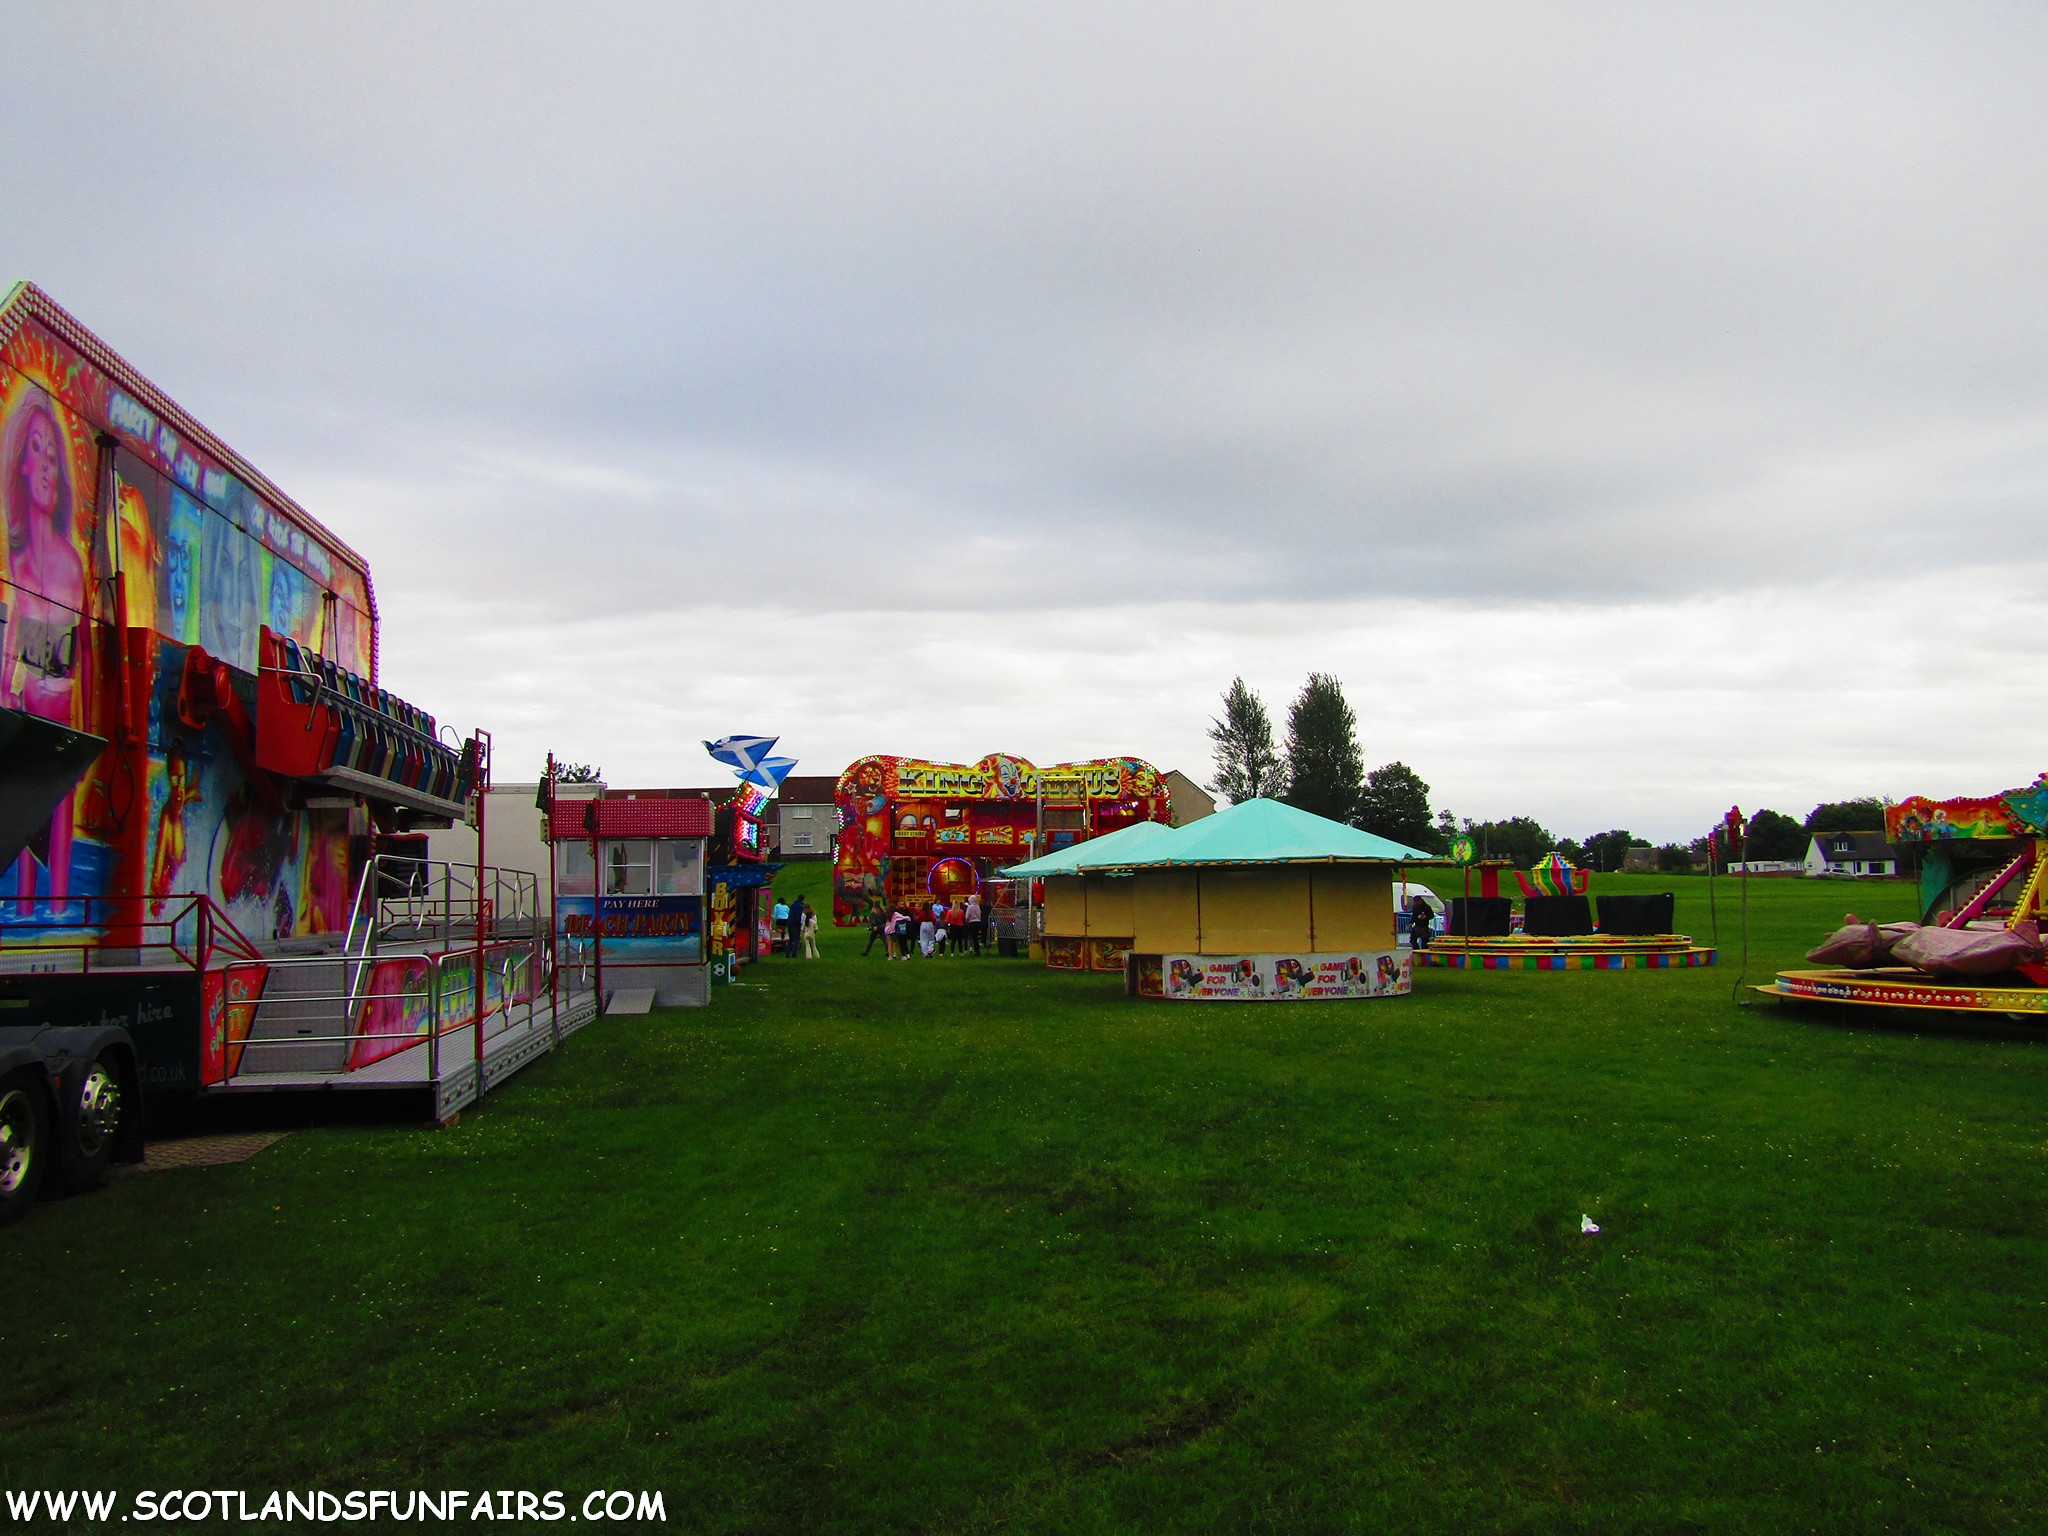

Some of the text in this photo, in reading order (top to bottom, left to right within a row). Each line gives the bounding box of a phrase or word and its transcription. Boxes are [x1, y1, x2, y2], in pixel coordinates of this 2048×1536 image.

[897, 768, 985, 795] KING
[603, 899, 660, 909] PAY HERE
[565, 912, 694, 935] BEACH PARTY
[711, 881, 728, 956] BOXER
[1201, 964, 1236, 972] A GAME
[1320, 962, 1346, 971] GAME
[1206, 976, 1226, 984] FOR
[1317, 975, 1336, 983] FOR
[1191, 987, 1239, 997] EVERYONE
[1300, 986, 1348, 997] EVERYONE
[208, 978, 249, 1028] BECH
[136, 1002, 173, 1024] hire
